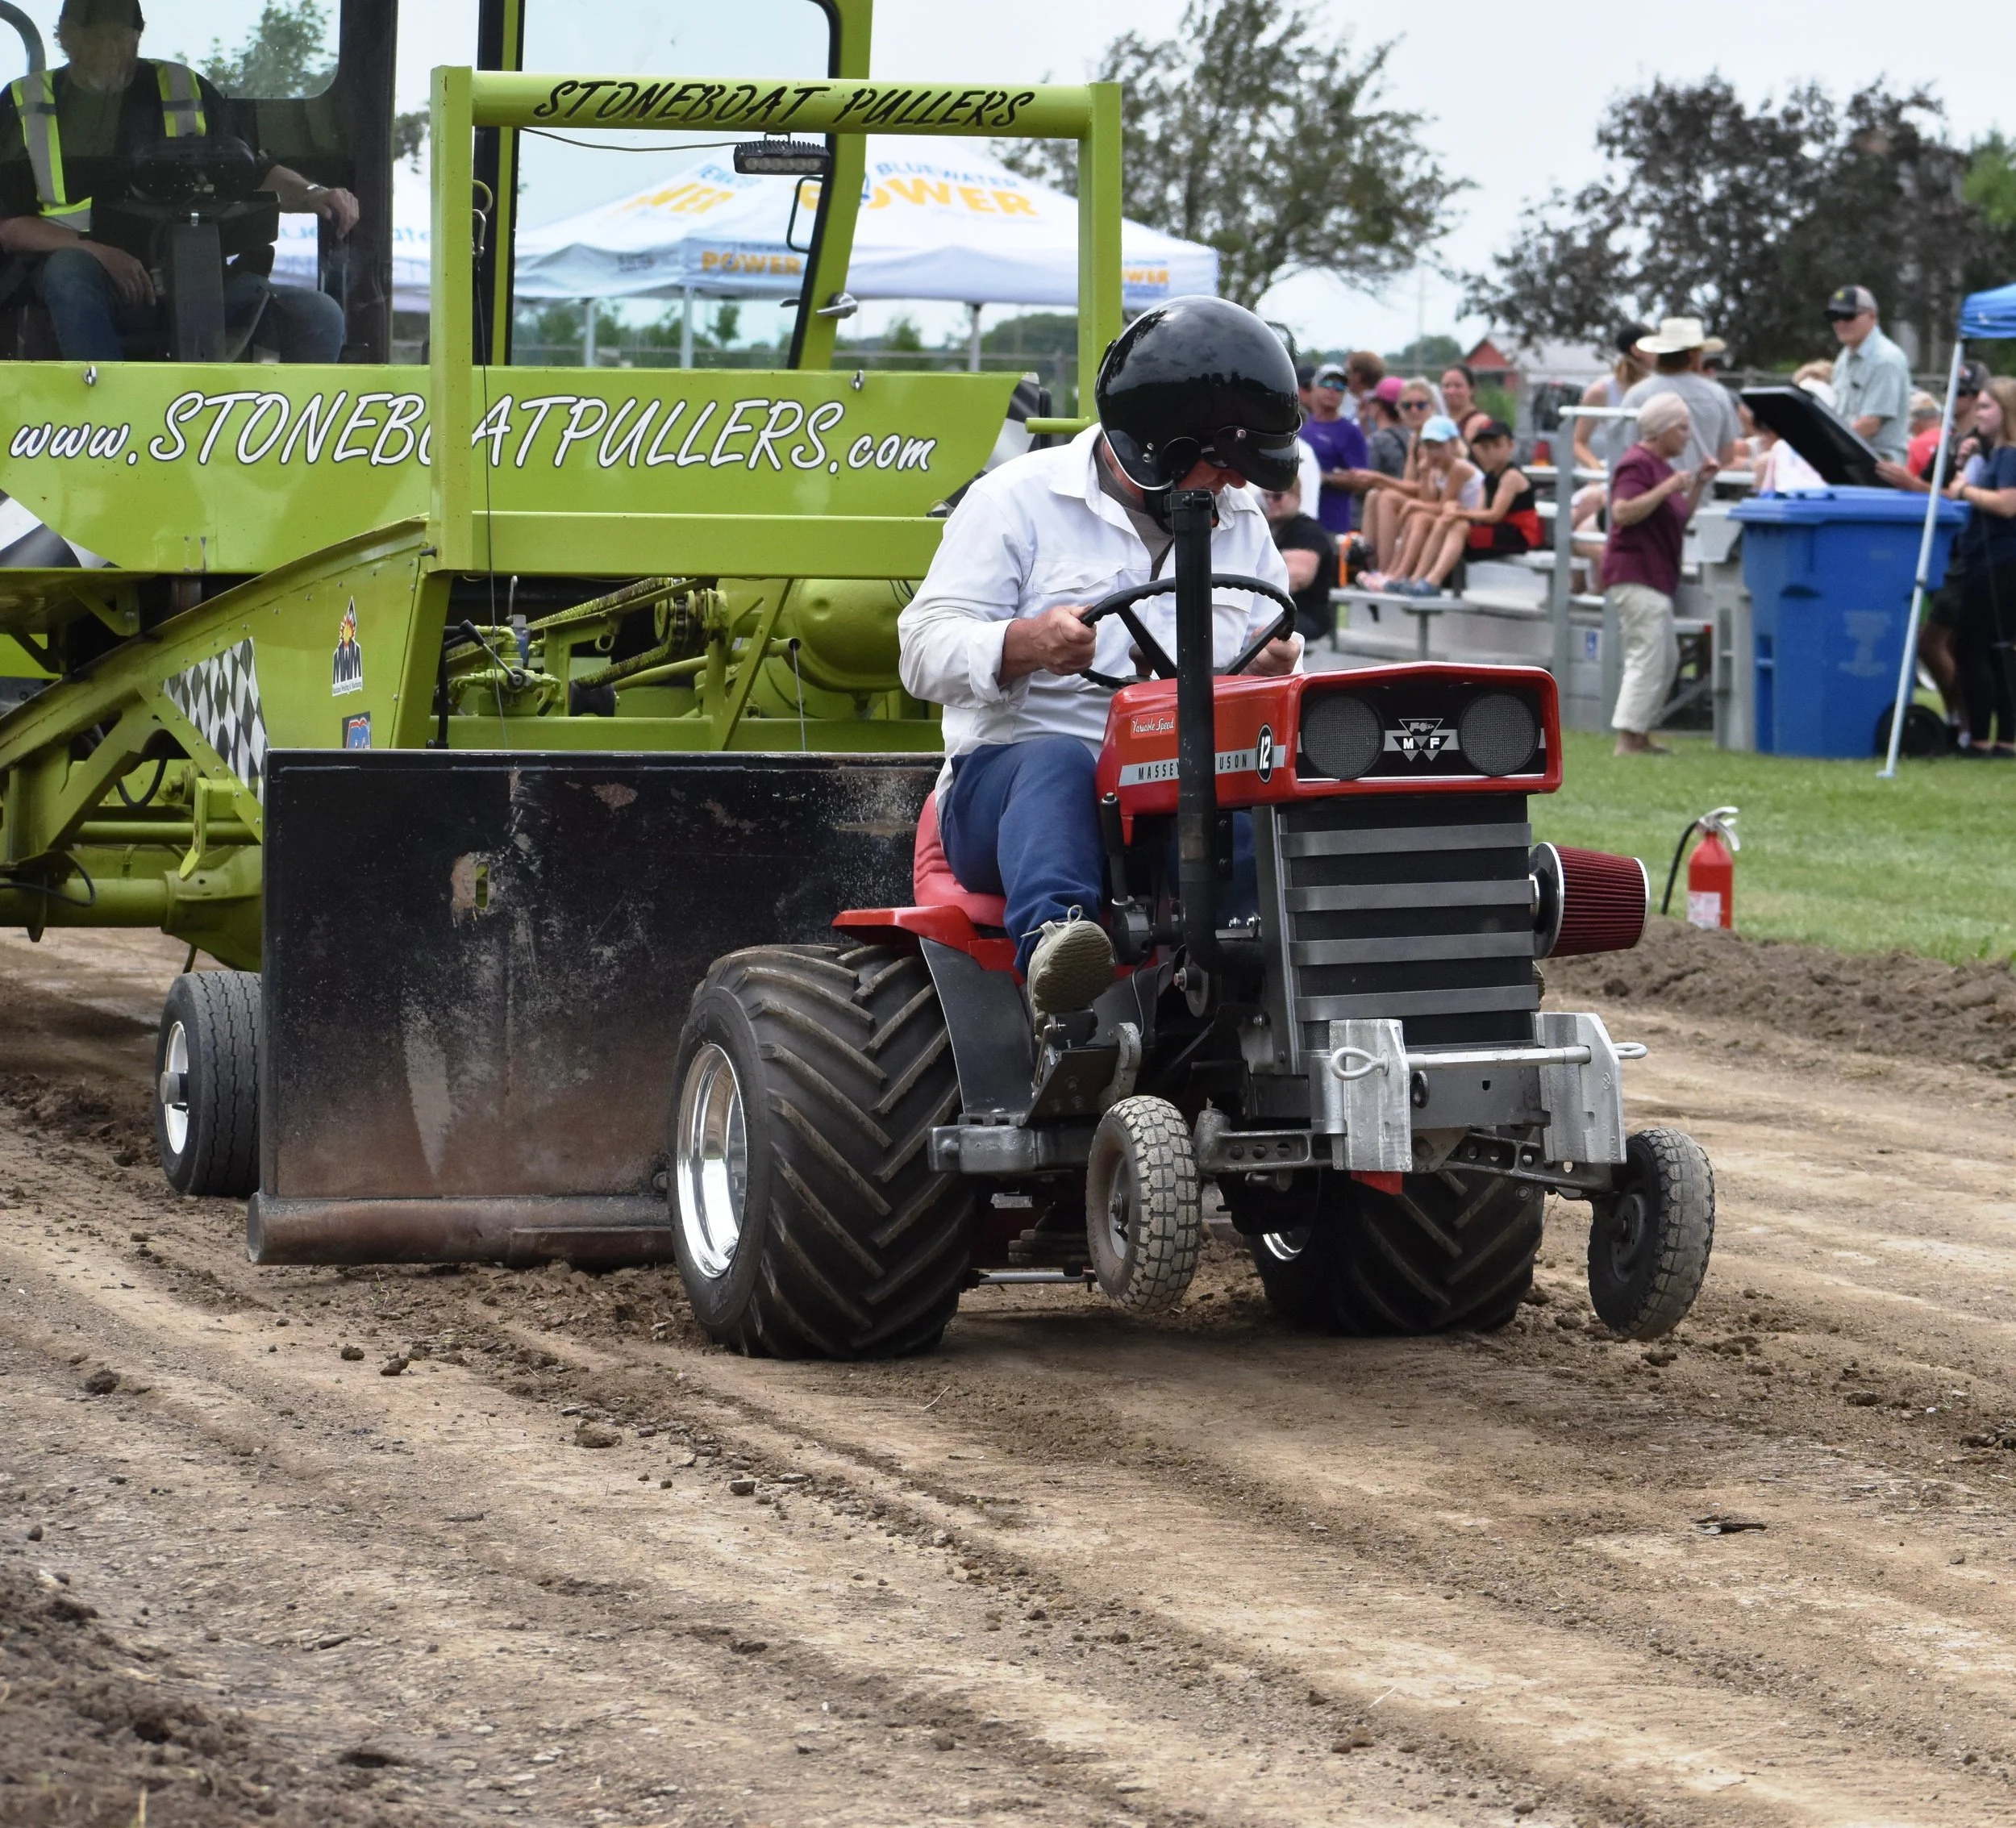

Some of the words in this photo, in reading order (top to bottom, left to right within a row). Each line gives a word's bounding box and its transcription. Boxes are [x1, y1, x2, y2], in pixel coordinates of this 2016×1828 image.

[533, 80, 829, 123] STONEBOAT
[833, 87, 1036, 126] PULLERS
[701, 250, 802, 277] POWER
[1132, 716, 1156, 733] Variable
[1156, 717, 1175, 734] Speed
[1259, 735, 1271, 770] 12
